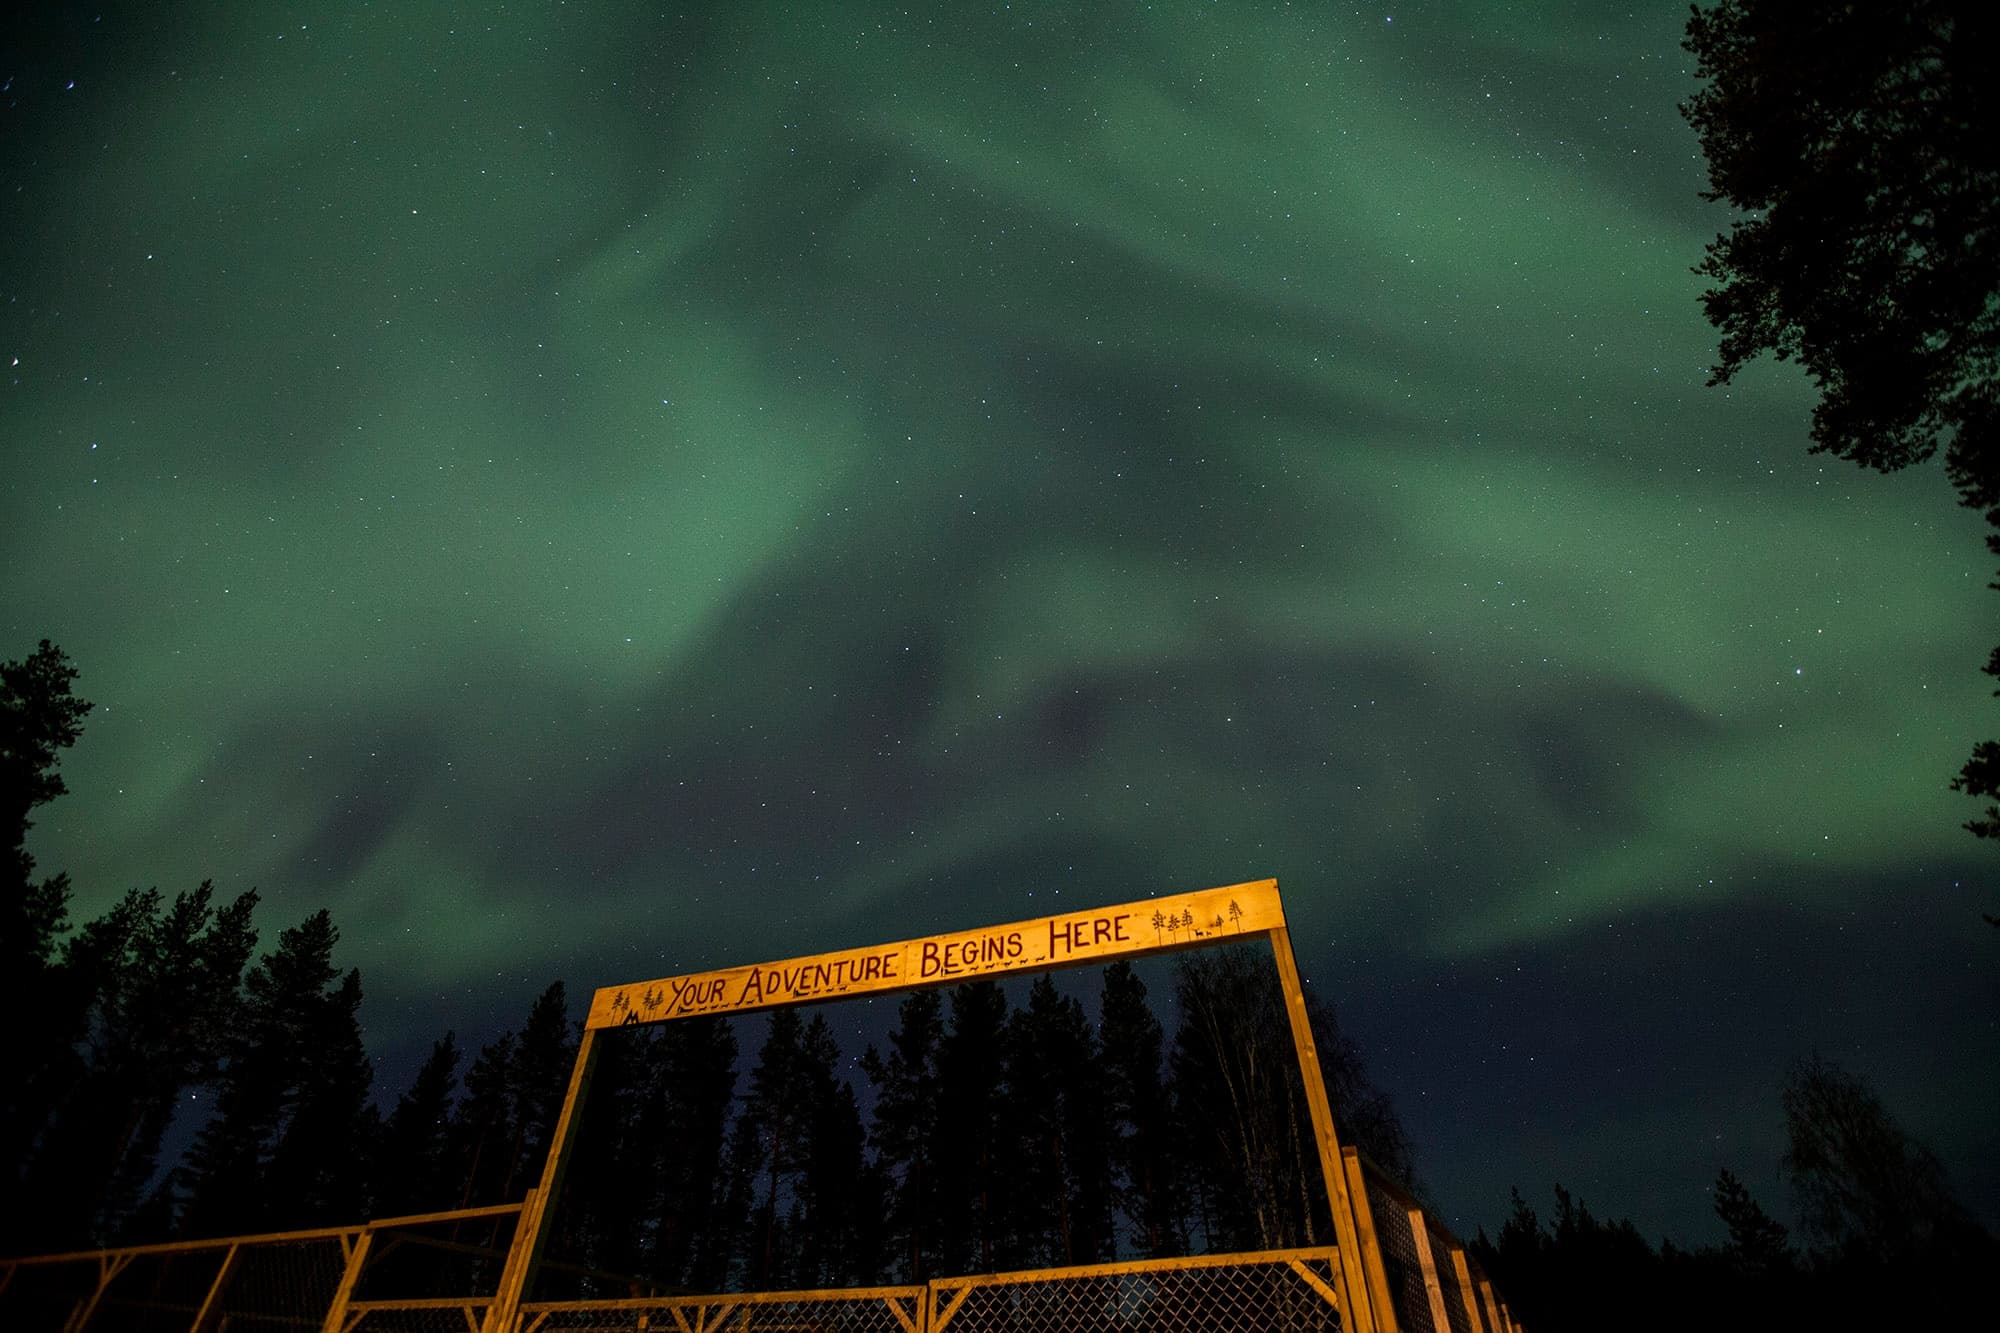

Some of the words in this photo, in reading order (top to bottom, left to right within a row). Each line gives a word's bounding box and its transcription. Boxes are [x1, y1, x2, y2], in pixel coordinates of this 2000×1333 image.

[665, 977, 726, 1015] YOUR
[739, 952, 899, 1005] ADVENTURE
[1049, 914, 1131, 960] HERE
